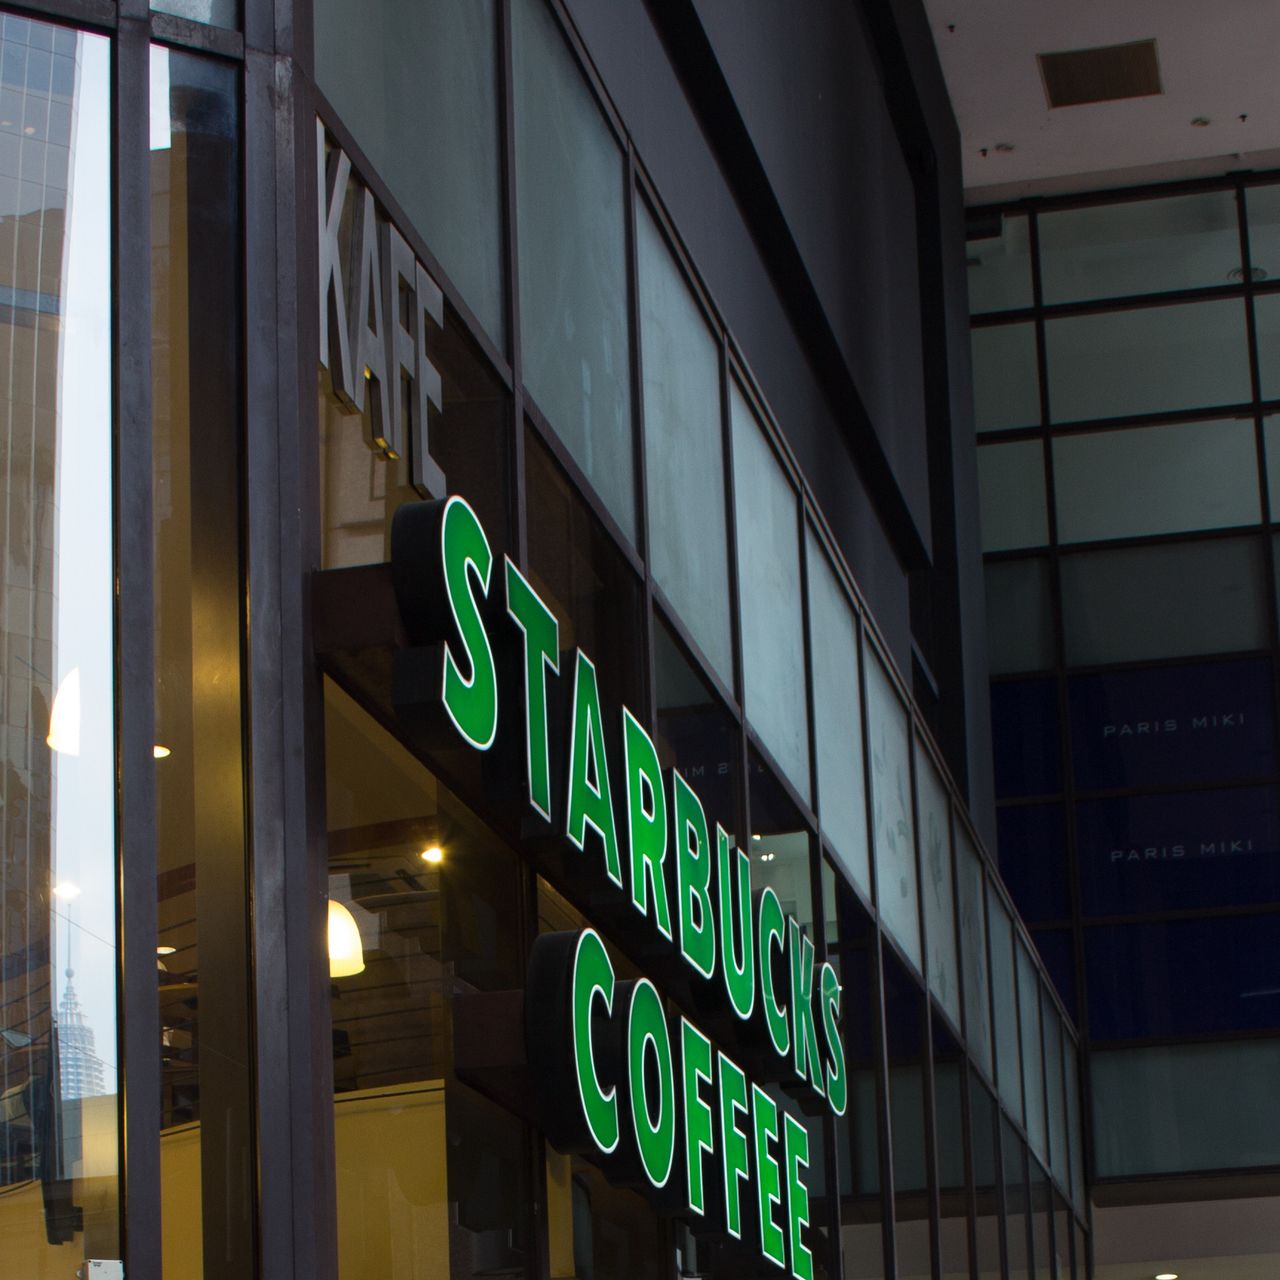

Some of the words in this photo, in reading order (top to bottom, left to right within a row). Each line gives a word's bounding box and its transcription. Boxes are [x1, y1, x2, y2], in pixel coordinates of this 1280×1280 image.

[315, 111, 447, 501] KAFE
[440, 494, 848, 1116] STARBUCKS
[1103, 718, 1178, 738] PARIS
[1192, 712, 1246, 730] MIKI
[1110, 844, 1186, 863] PARIS
[1200, 838, 1253, 856] MIKI
